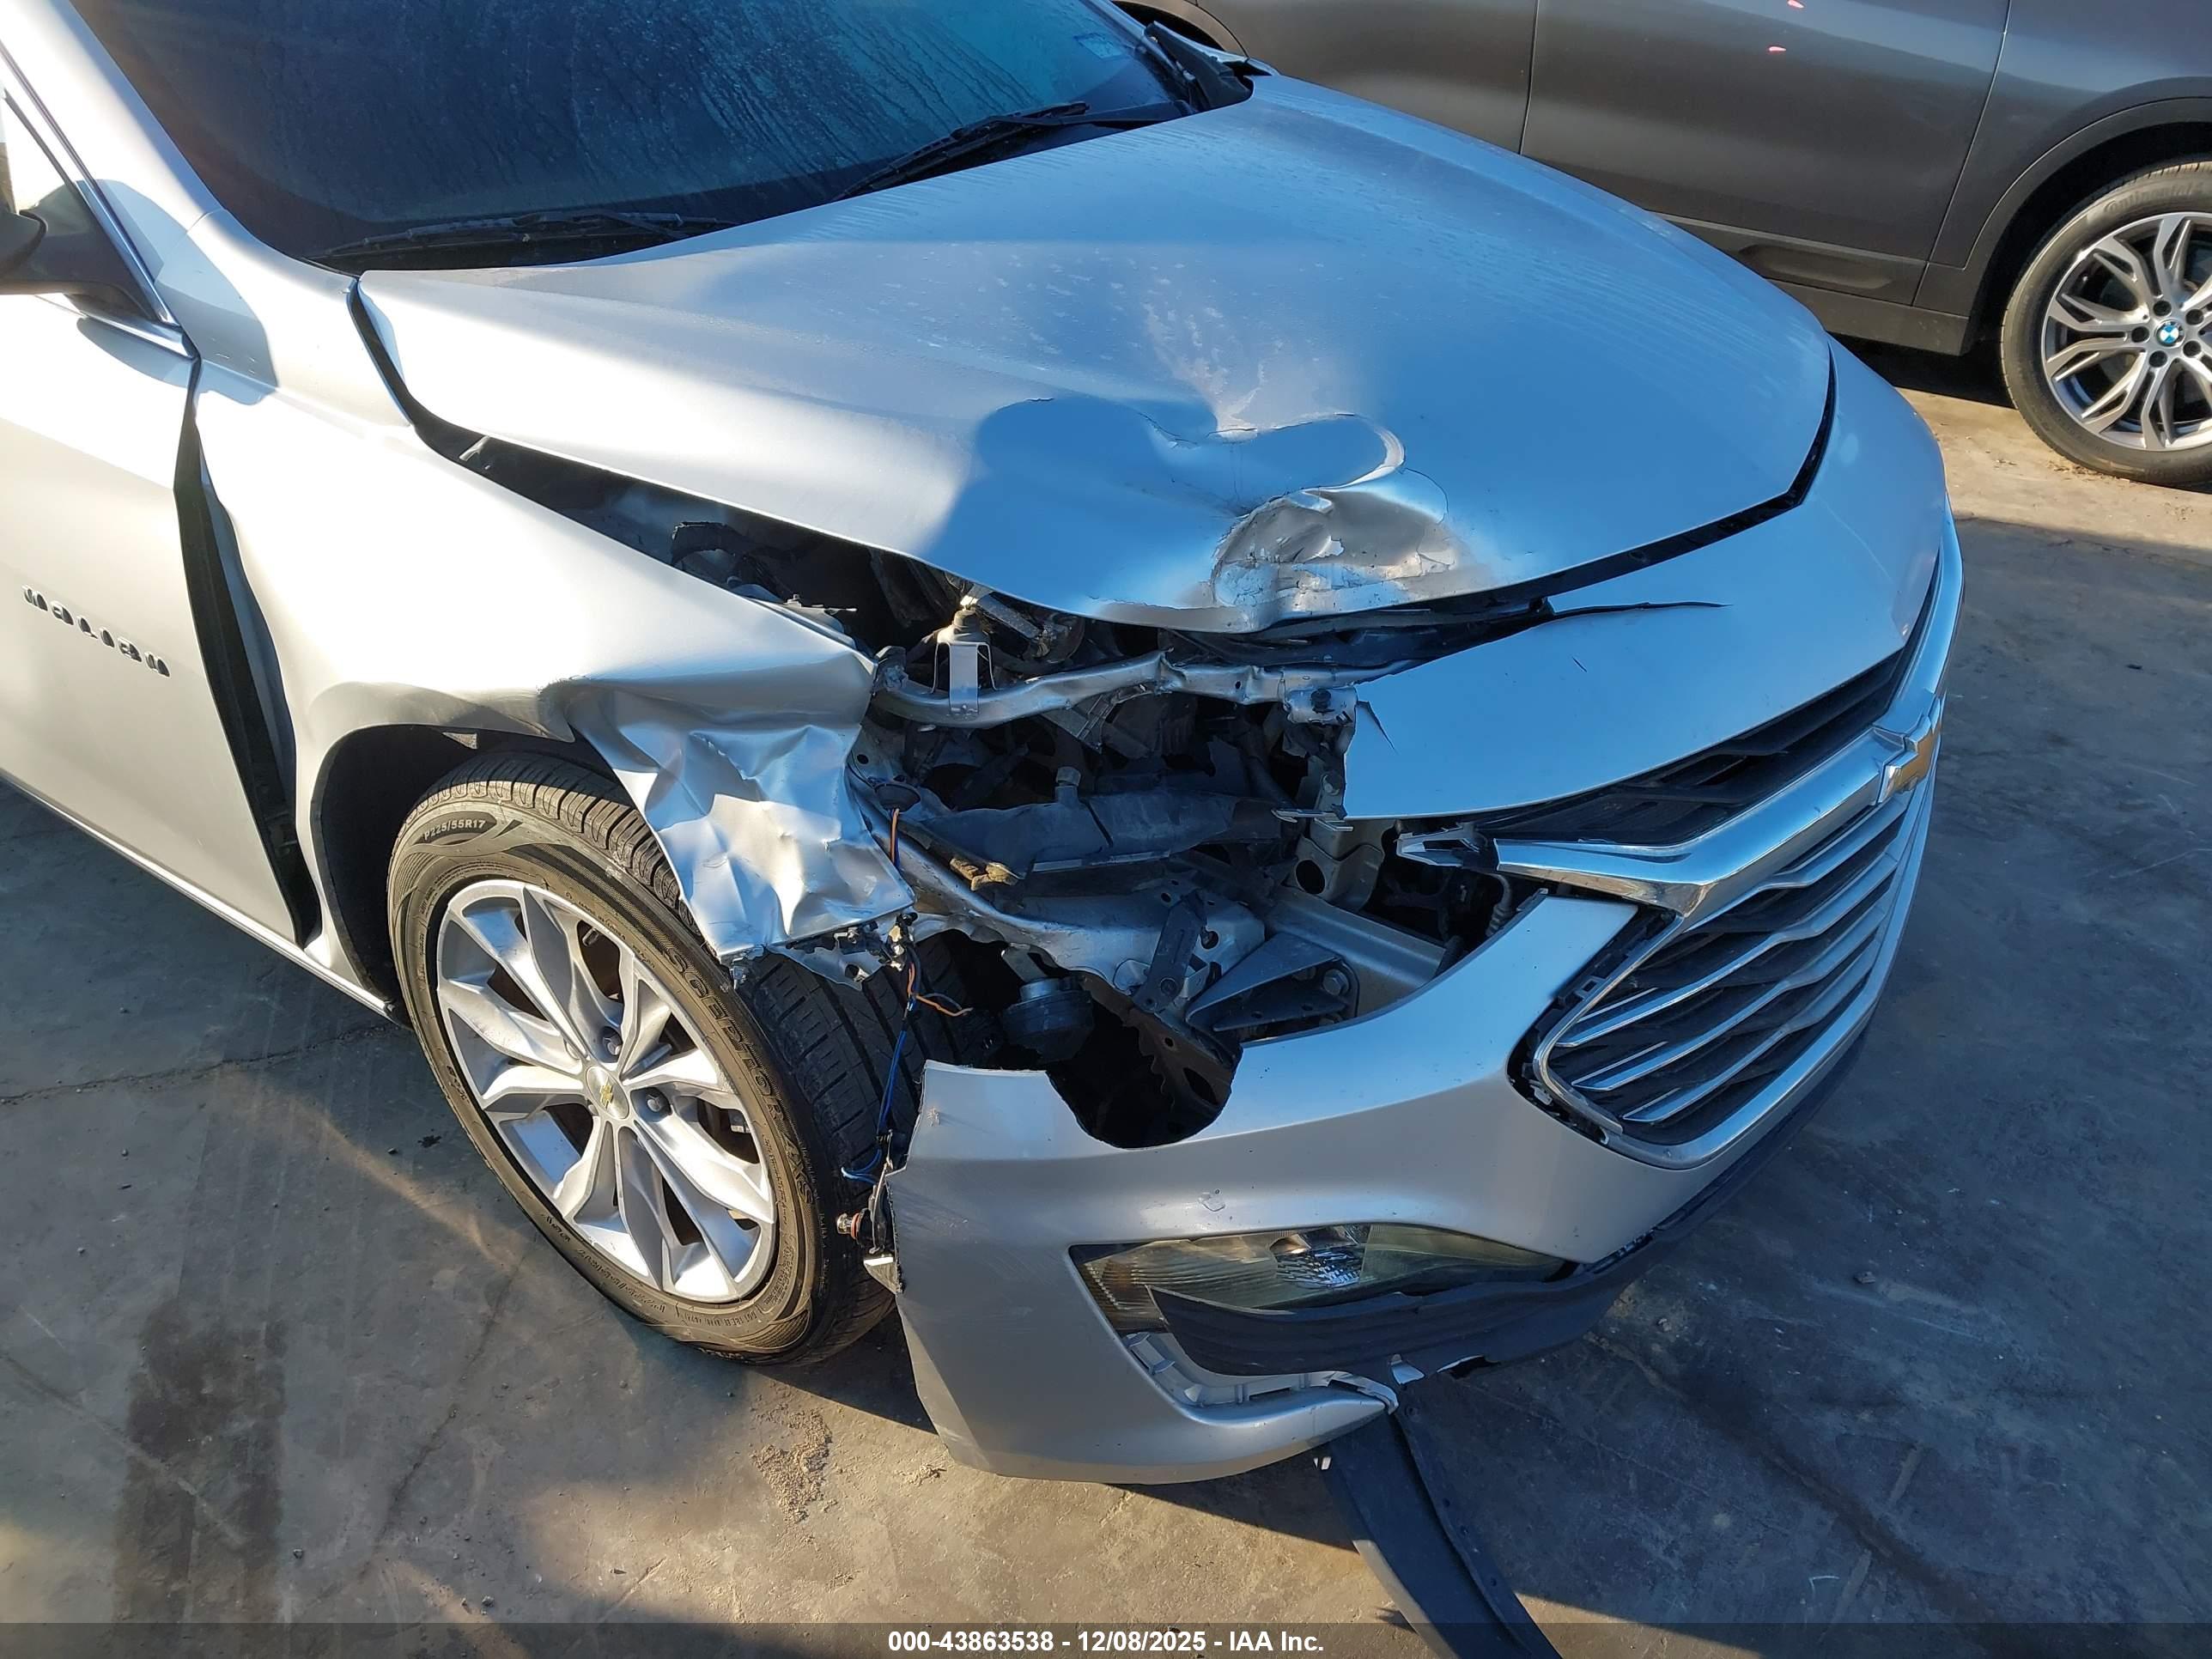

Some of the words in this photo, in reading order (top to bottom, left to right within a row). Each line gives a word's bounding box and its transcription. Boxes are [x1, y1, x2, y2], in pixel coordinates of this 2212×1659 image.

[423, 818, 487, 842] P225/55R17
[664, 949, 787, 1122] SCEPTOR
[777, 1134, 816, 1206] 4XS
